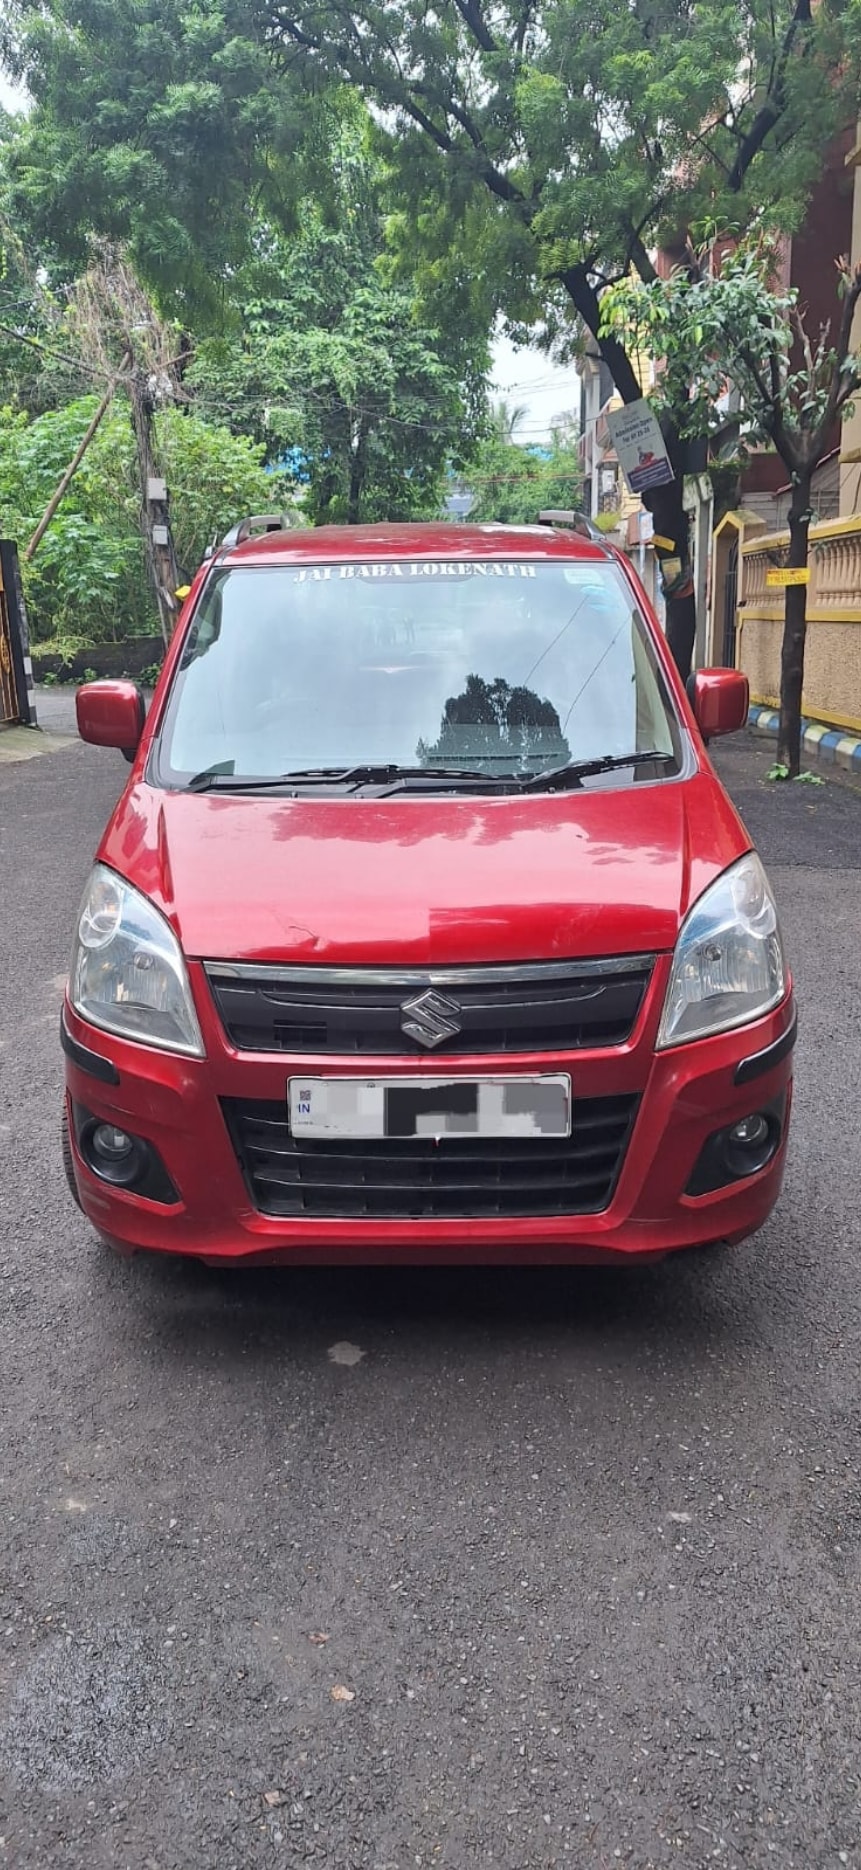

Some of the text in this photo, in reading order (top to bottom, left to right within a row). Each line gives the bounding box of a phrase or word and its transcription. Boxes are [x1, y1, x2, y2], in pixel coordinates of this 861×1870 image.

[293, 562, 536, 582] JAI BABA LOKENATH
[298, 1104, 310, 1113] IN
